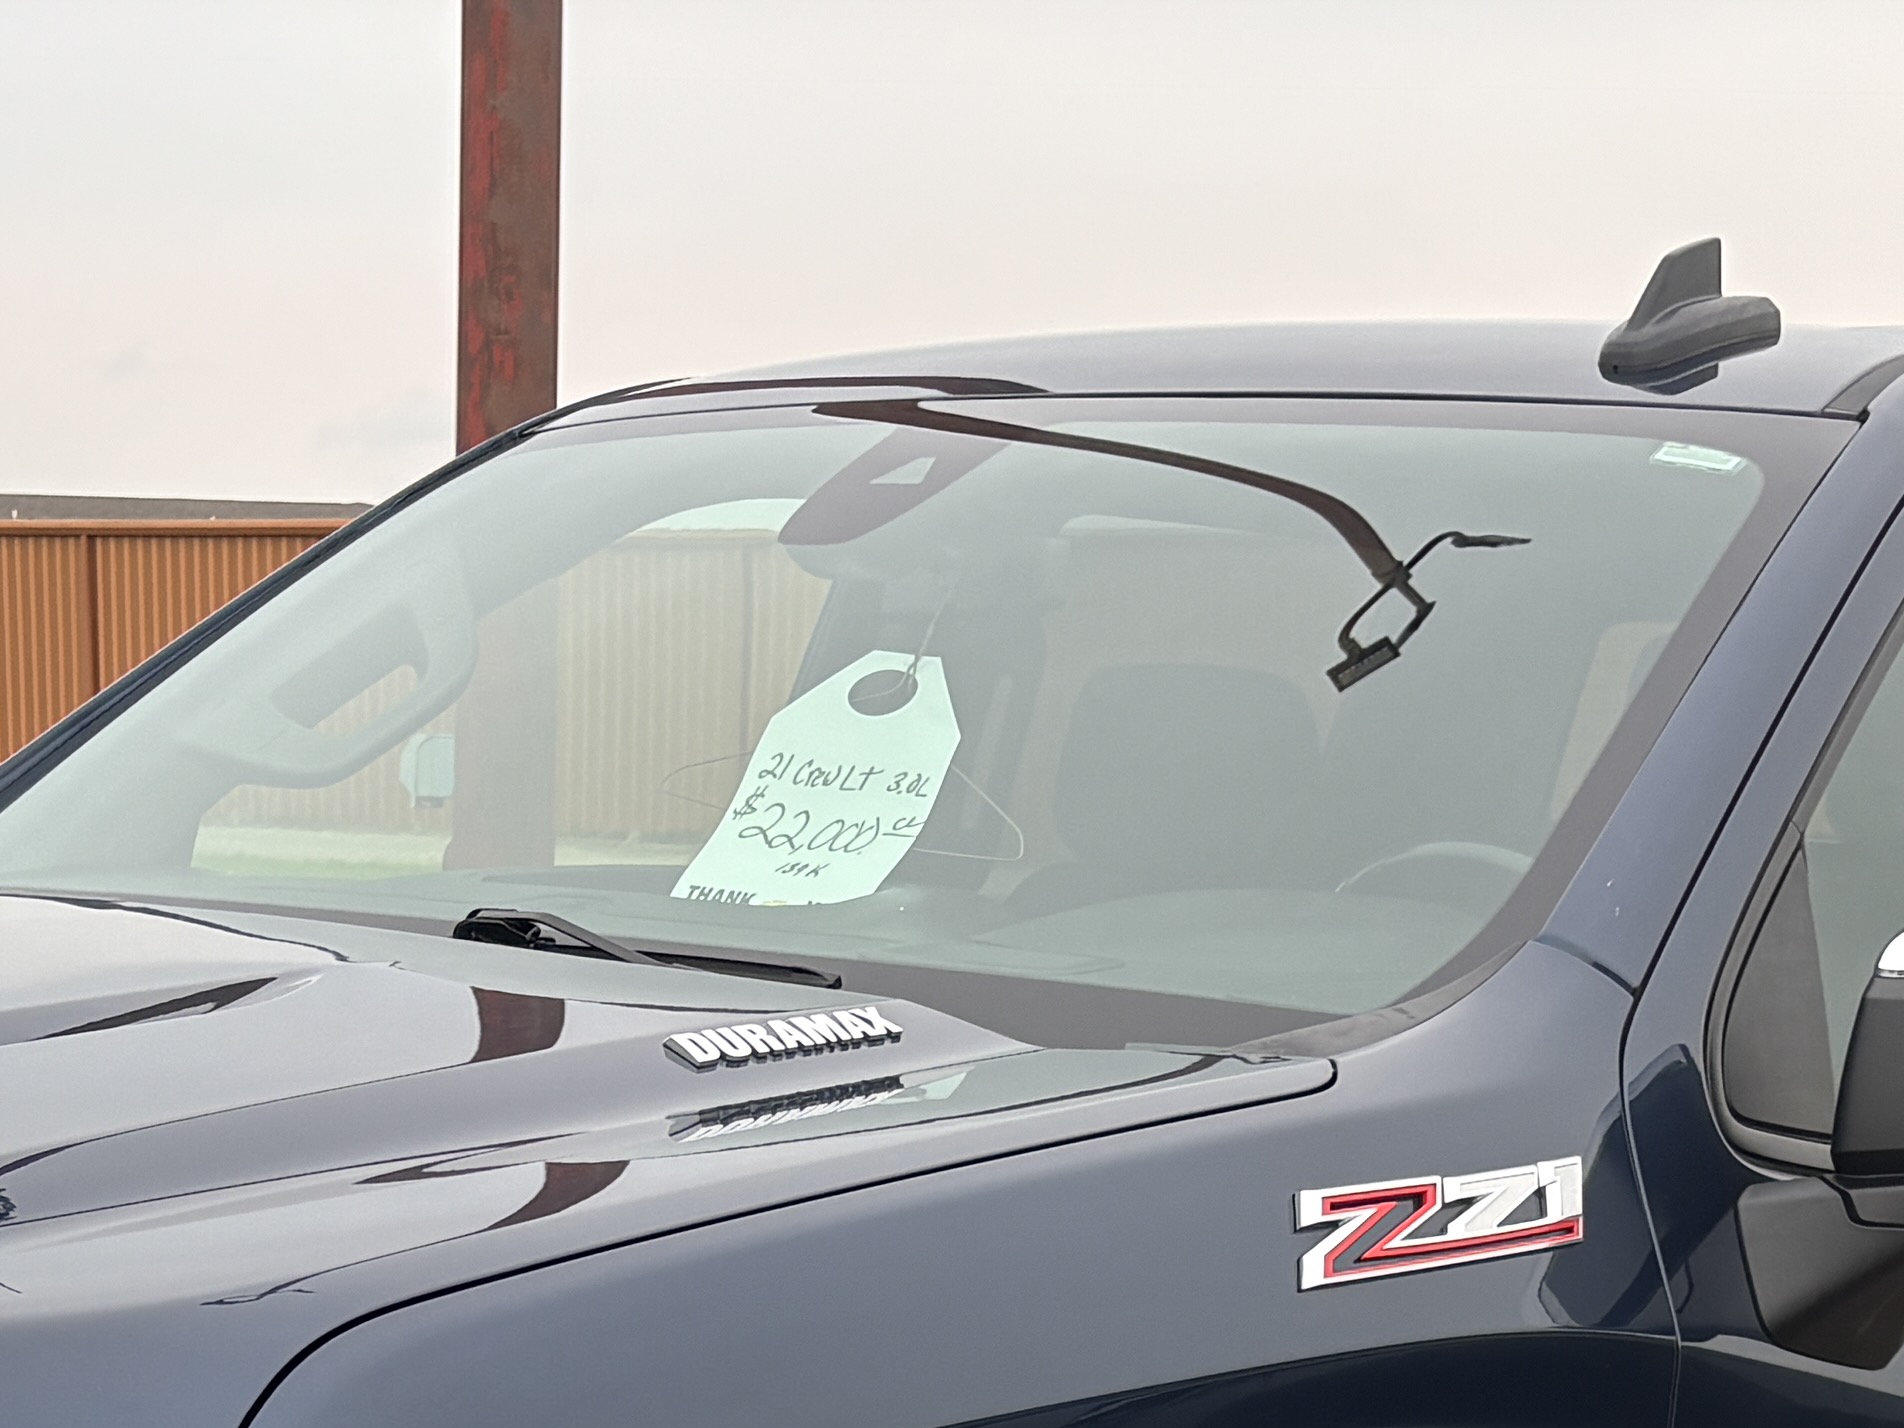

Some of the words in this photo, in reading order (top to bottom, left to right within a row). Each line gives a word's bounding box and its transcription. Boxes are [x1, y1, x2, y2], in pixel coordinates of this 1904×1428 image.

[758, 752, 795, 780] 21
[886, 772, 931, 798] 3.0L
[667, 1006, 904, 1068] DURAMAX
